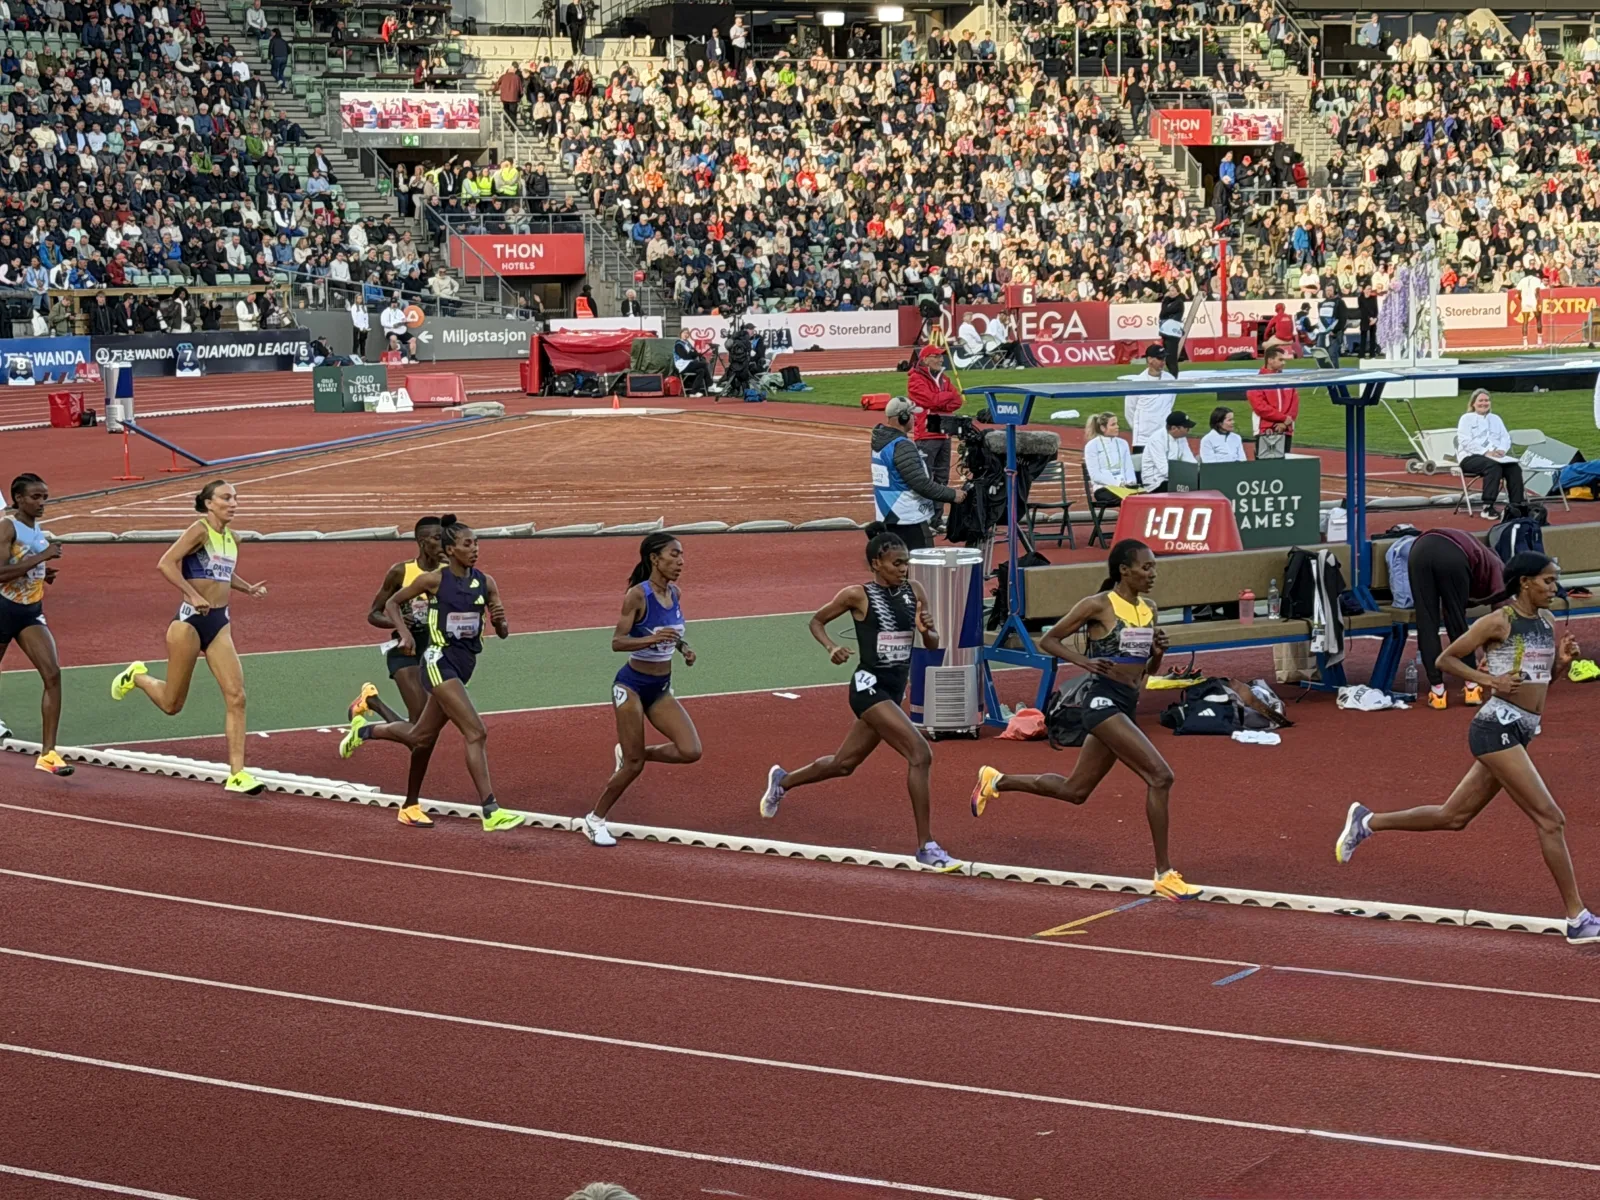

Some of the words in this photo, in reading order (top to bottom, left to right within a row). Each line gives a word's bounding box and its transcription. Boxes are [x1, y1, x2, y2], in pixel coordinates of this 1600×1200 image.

[1163, 118, 1200, 131] THON
[493, 243, 544, 258] THON
[501, 262, 535, 270] HOTELS
[1022, 288, 1033, 304] 6
[1445, 305, 1502, 317] Storebrand
[1542, 297, 1598, 314] EXTRA
[829, 324, 892, 335] Storebrand
[442, 328, 527, 346] Miljøstasjon
[183, 350, 192, 362] 7
[196, 343, 255, 359] DIAMOND
[300, 345, 308, 357] 6
[16, 358, 27, 370] 8
[355, 375, 375, 384] OSLO
[997, 404, 1019, 414] DIMA
[1236, 479, 1284, 496] OSLO
[1231, 495, 1302, 513] ISLETT
[1144, 507, 1213, 541] 1:00
[1240, 512, 1295, 530] AMES
[1175, 542, 1210, 551] OMEGA
[181, 604, 192, 616] 10
[857, 673, 871, 686] 14
